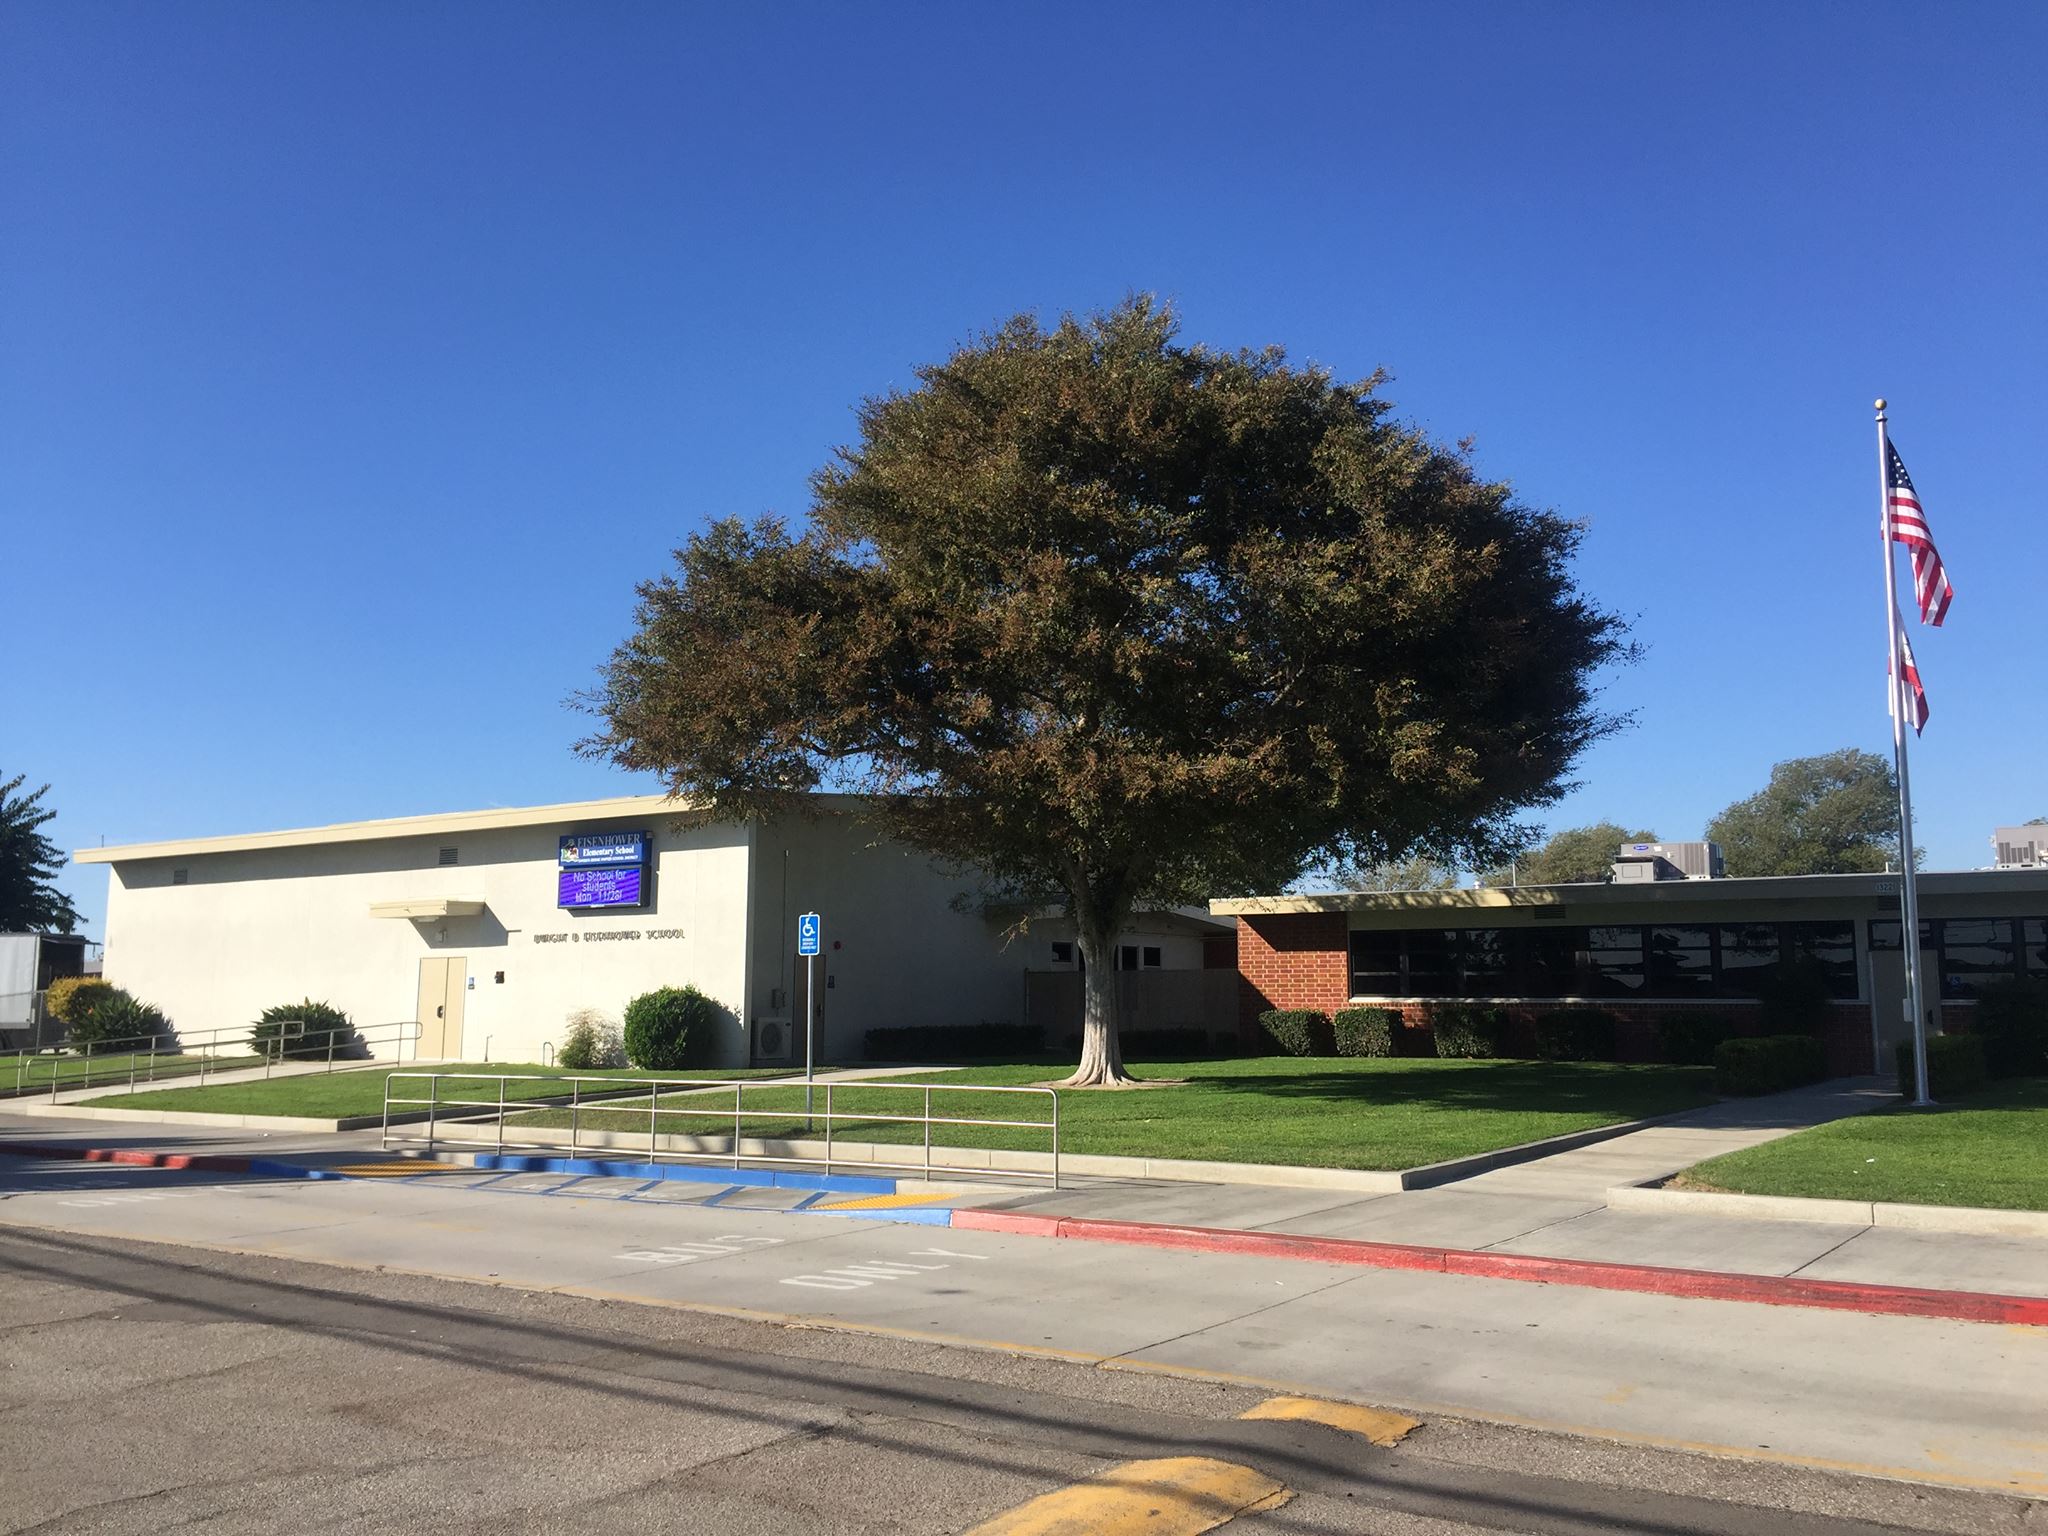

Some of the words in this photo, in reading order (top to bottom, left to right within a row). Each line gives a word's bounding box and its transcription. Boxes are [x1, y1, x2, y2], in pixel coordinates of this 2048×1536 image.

[577, 834, 640, 847] EISENHOWER
[582, 848, 614, 857] Elementary
[615, 845, 635, 855] School
[573, 872, 585, 882] No
[586, 871, 613, 882] School
[615, 869, 626, 879] for
[582, 880, 616, 892] students
[645, 928, 686, 940] SCHOOL
[612, 1234, 786, 1263] BUS
[778, 1247, 990, 1290] ONLY
